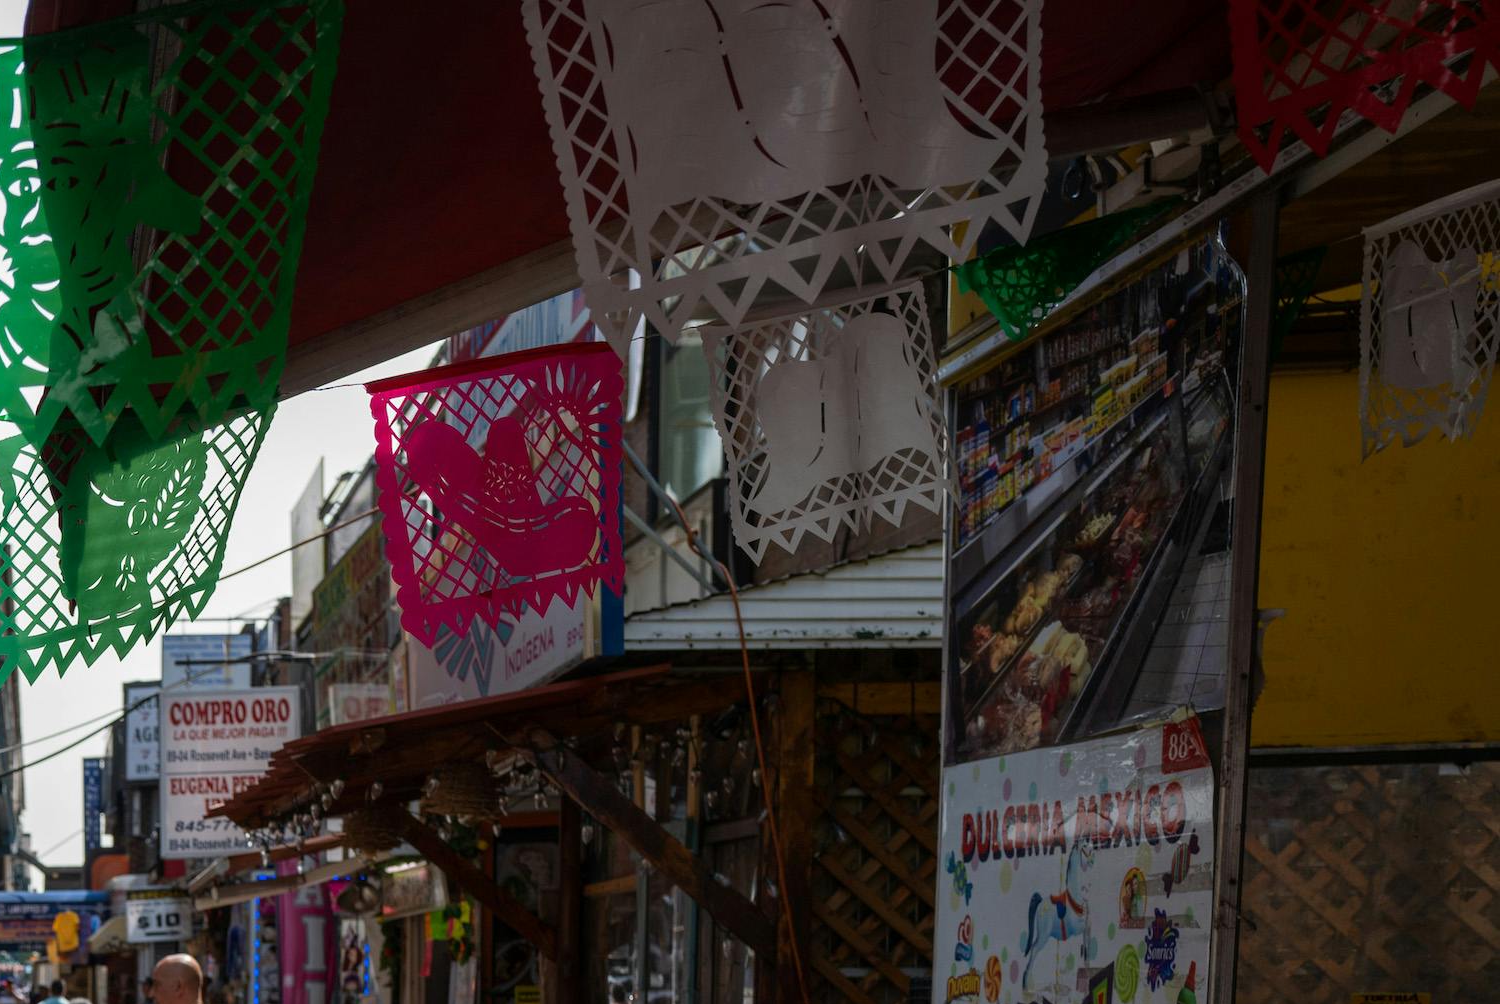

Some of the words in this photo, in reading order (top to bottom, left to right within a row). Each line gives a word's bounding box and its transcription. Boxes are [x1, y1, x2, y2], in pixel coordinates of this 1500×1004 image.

[170, 699, 247, 725] COMPRO
[251, 697, 291, 723] ORO
[173, 729, 187, 741] LA
[188, 729, 209, 741] QUE
[212, 728, 246, 740] MEJOR
[248, 726, 275, 738] PAGA
[190, 749, 229, 761] Roosevelt
[231, 749, 246, 760] Ave
[170, 776, 229, 795] EUGENIA
[962, 800, 1067, 863] DULCERIA
[1074, 781, 1187, 850] MEXICO
